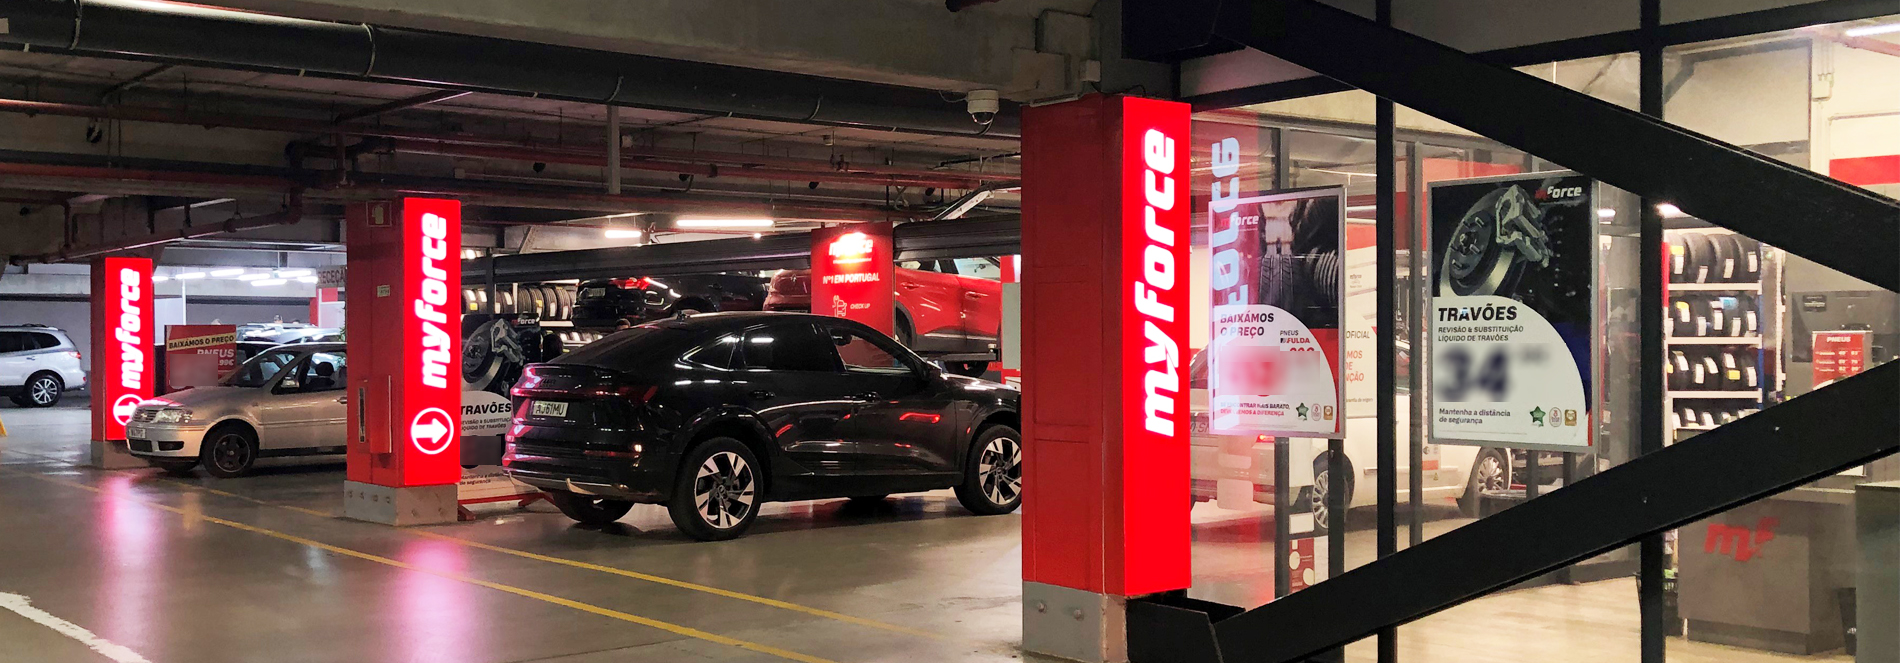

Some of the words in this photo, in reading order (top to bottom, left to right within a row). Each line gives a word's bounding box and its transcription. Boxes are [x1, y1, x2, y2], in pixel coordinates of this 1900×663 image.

[834, 274, 845, 283] EM
[845, 272, 880, 283] PORTUGAL
[1134, 127, 1179, 438] myforce
[415, 212, 451, 389] myforce
[1220, 310, 1275, 324] BAIXÁMOS
[1438, 303, 1517, 322] TRAVÕES
[115, 267, 141, 389] myforce
[1220, 327, 1227, 336] O
[1230, 326, 1265, 339] PREÇO
[1346, 330, 1370, 339] OFICIAL
[1474, 325, 1524, 333] SUBSTITUIÇÃO
[168, 339, 204, 349] BAIXÁMOS
[204, 337, 210, 345] O
[211, 334, 235, 344] PREÇO
[1438, 334, 1466, 342] LÍQUIDO
[1478, 334, 1509, 342] TRAVÕES
[460, 401, 511, 415] TRAVÕES
[1479, 409, 1511, 417] distância
